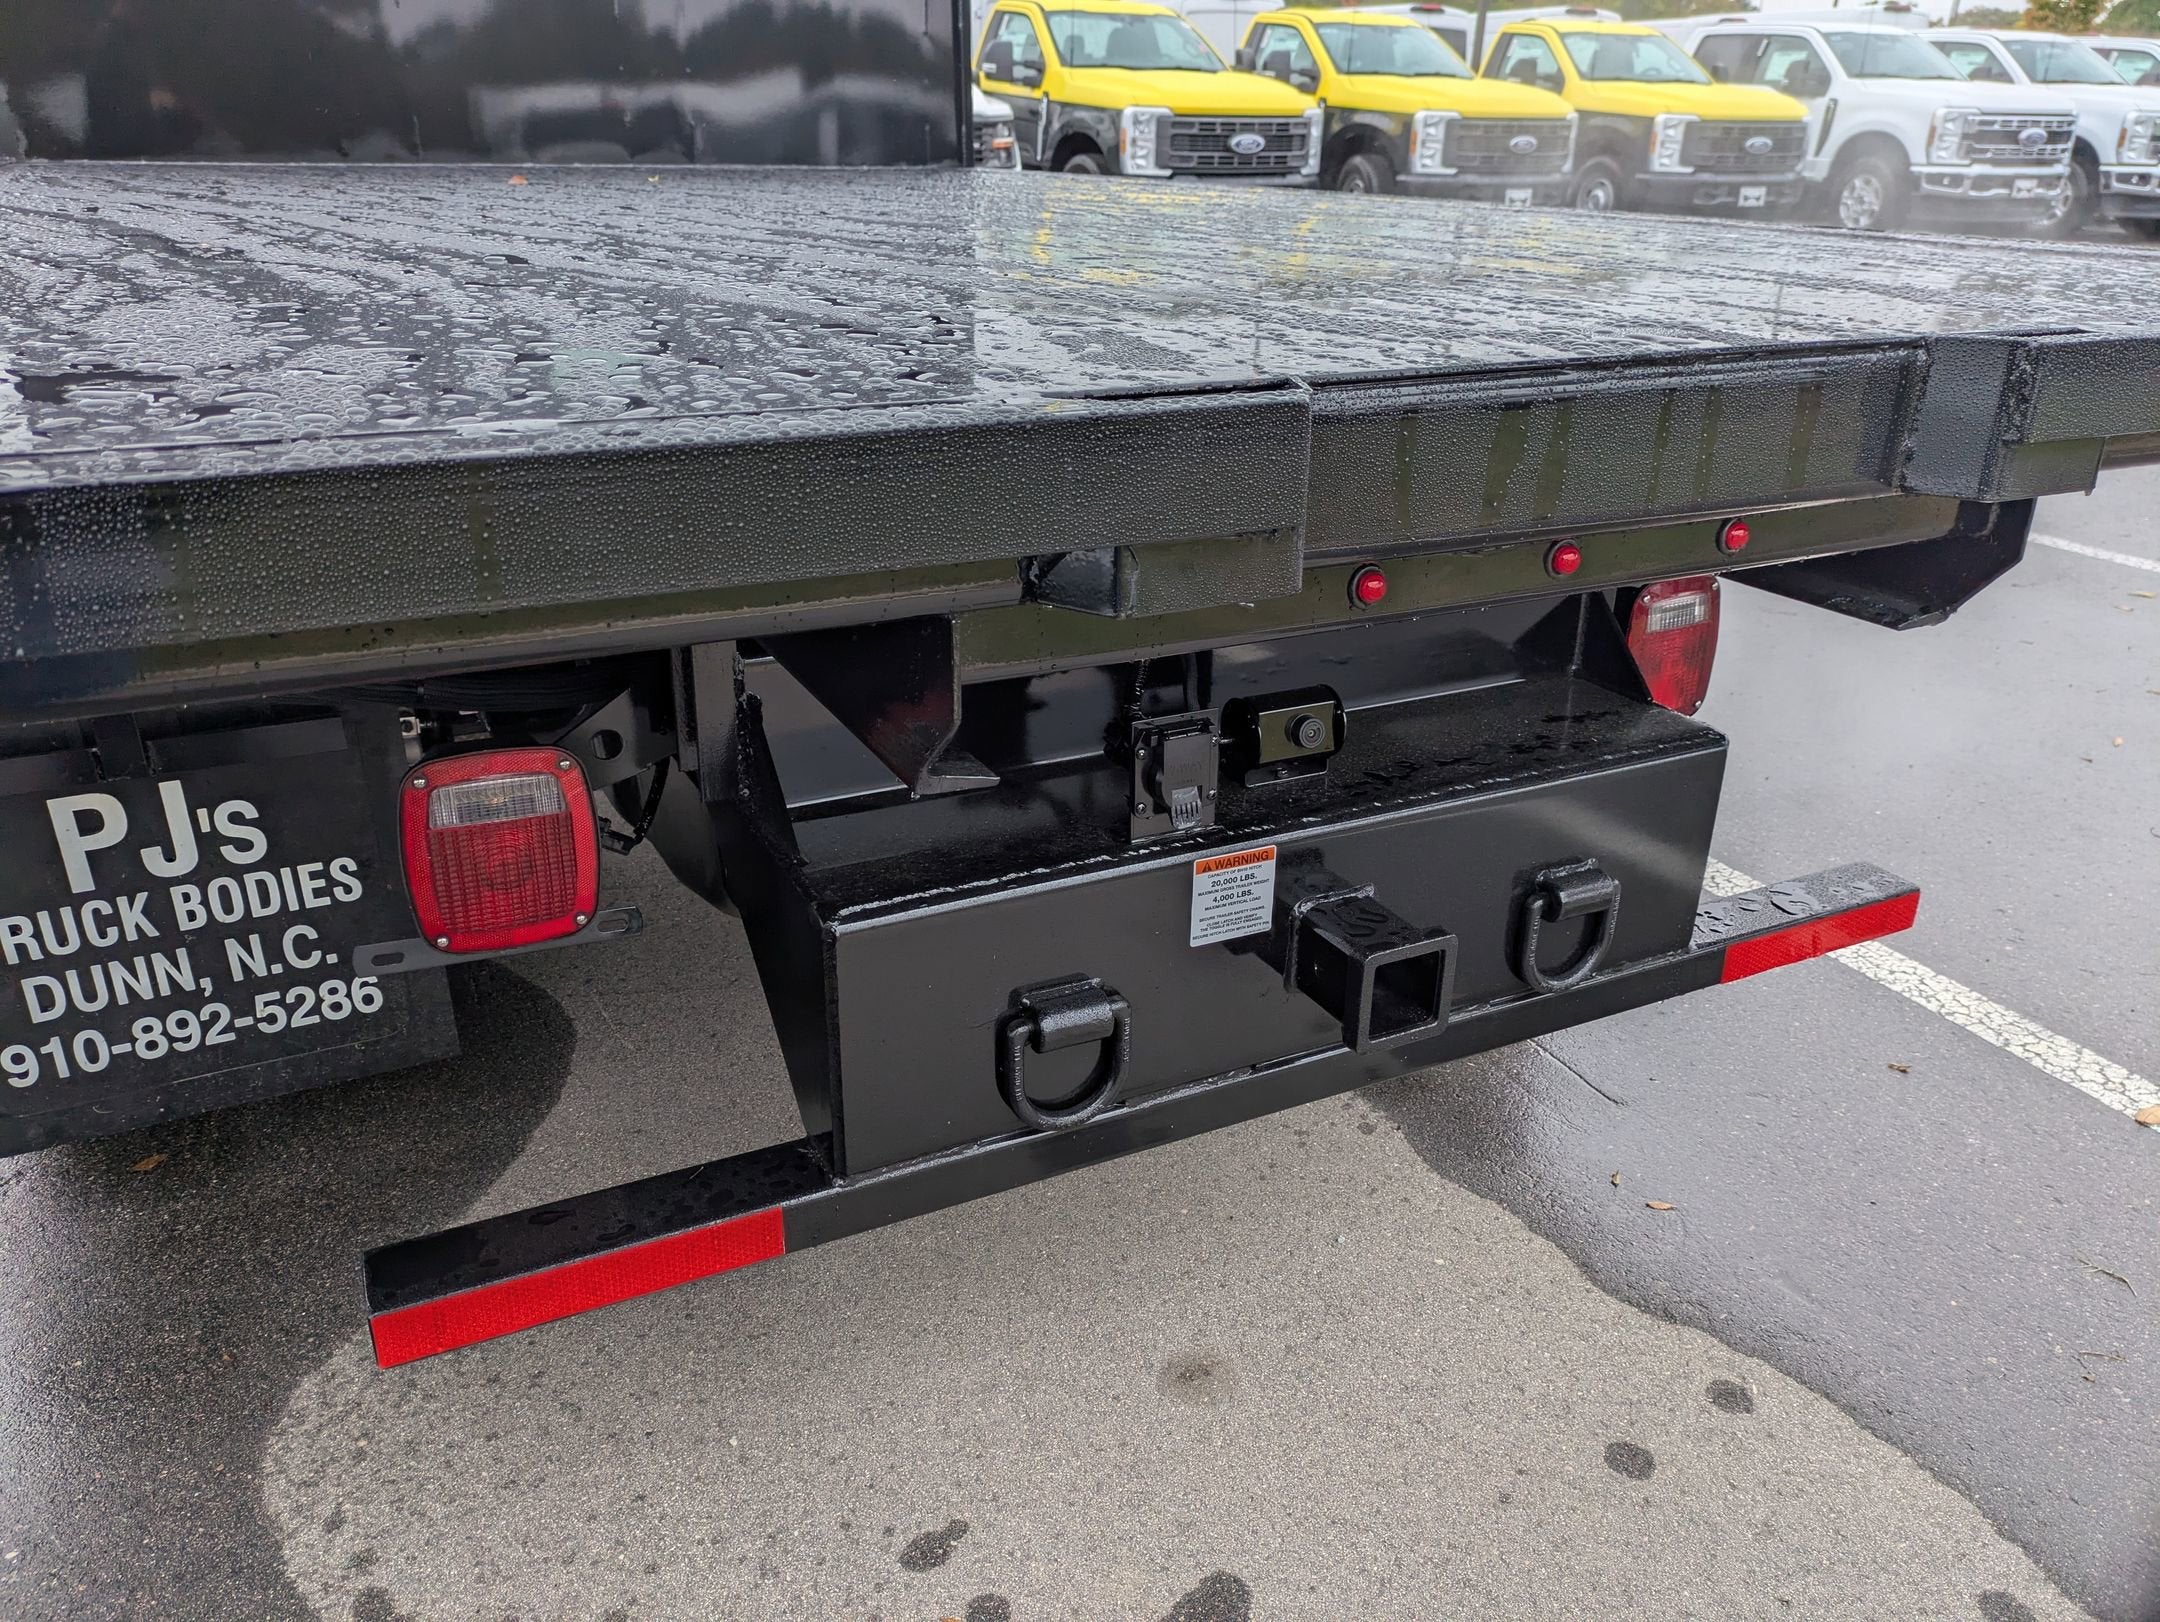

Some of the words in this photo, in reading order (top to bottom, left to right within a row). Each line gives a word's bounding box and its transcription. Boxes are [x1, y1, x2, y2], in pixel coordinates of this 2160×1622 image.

[1214, 851, 1268, 870] WARNING
[1211, 877, 1237, 888] 20,000
[1240, 873, 1257, 882] LBS.
[170, 857, 362, 931] BODIES
[1198, 888, 1219, 896] MAXIMUM
[1213, 893, 1235, 903] 4,000
[1237, 890, 1254, 898] LBS.
[1205, 903, 1226, 911] MAXIMUM
[21, 948, 213, 1023] DUNN,
[225, 925, 338, 982] N.C.
[0, 976, 383, 1087] 910-892-5286
